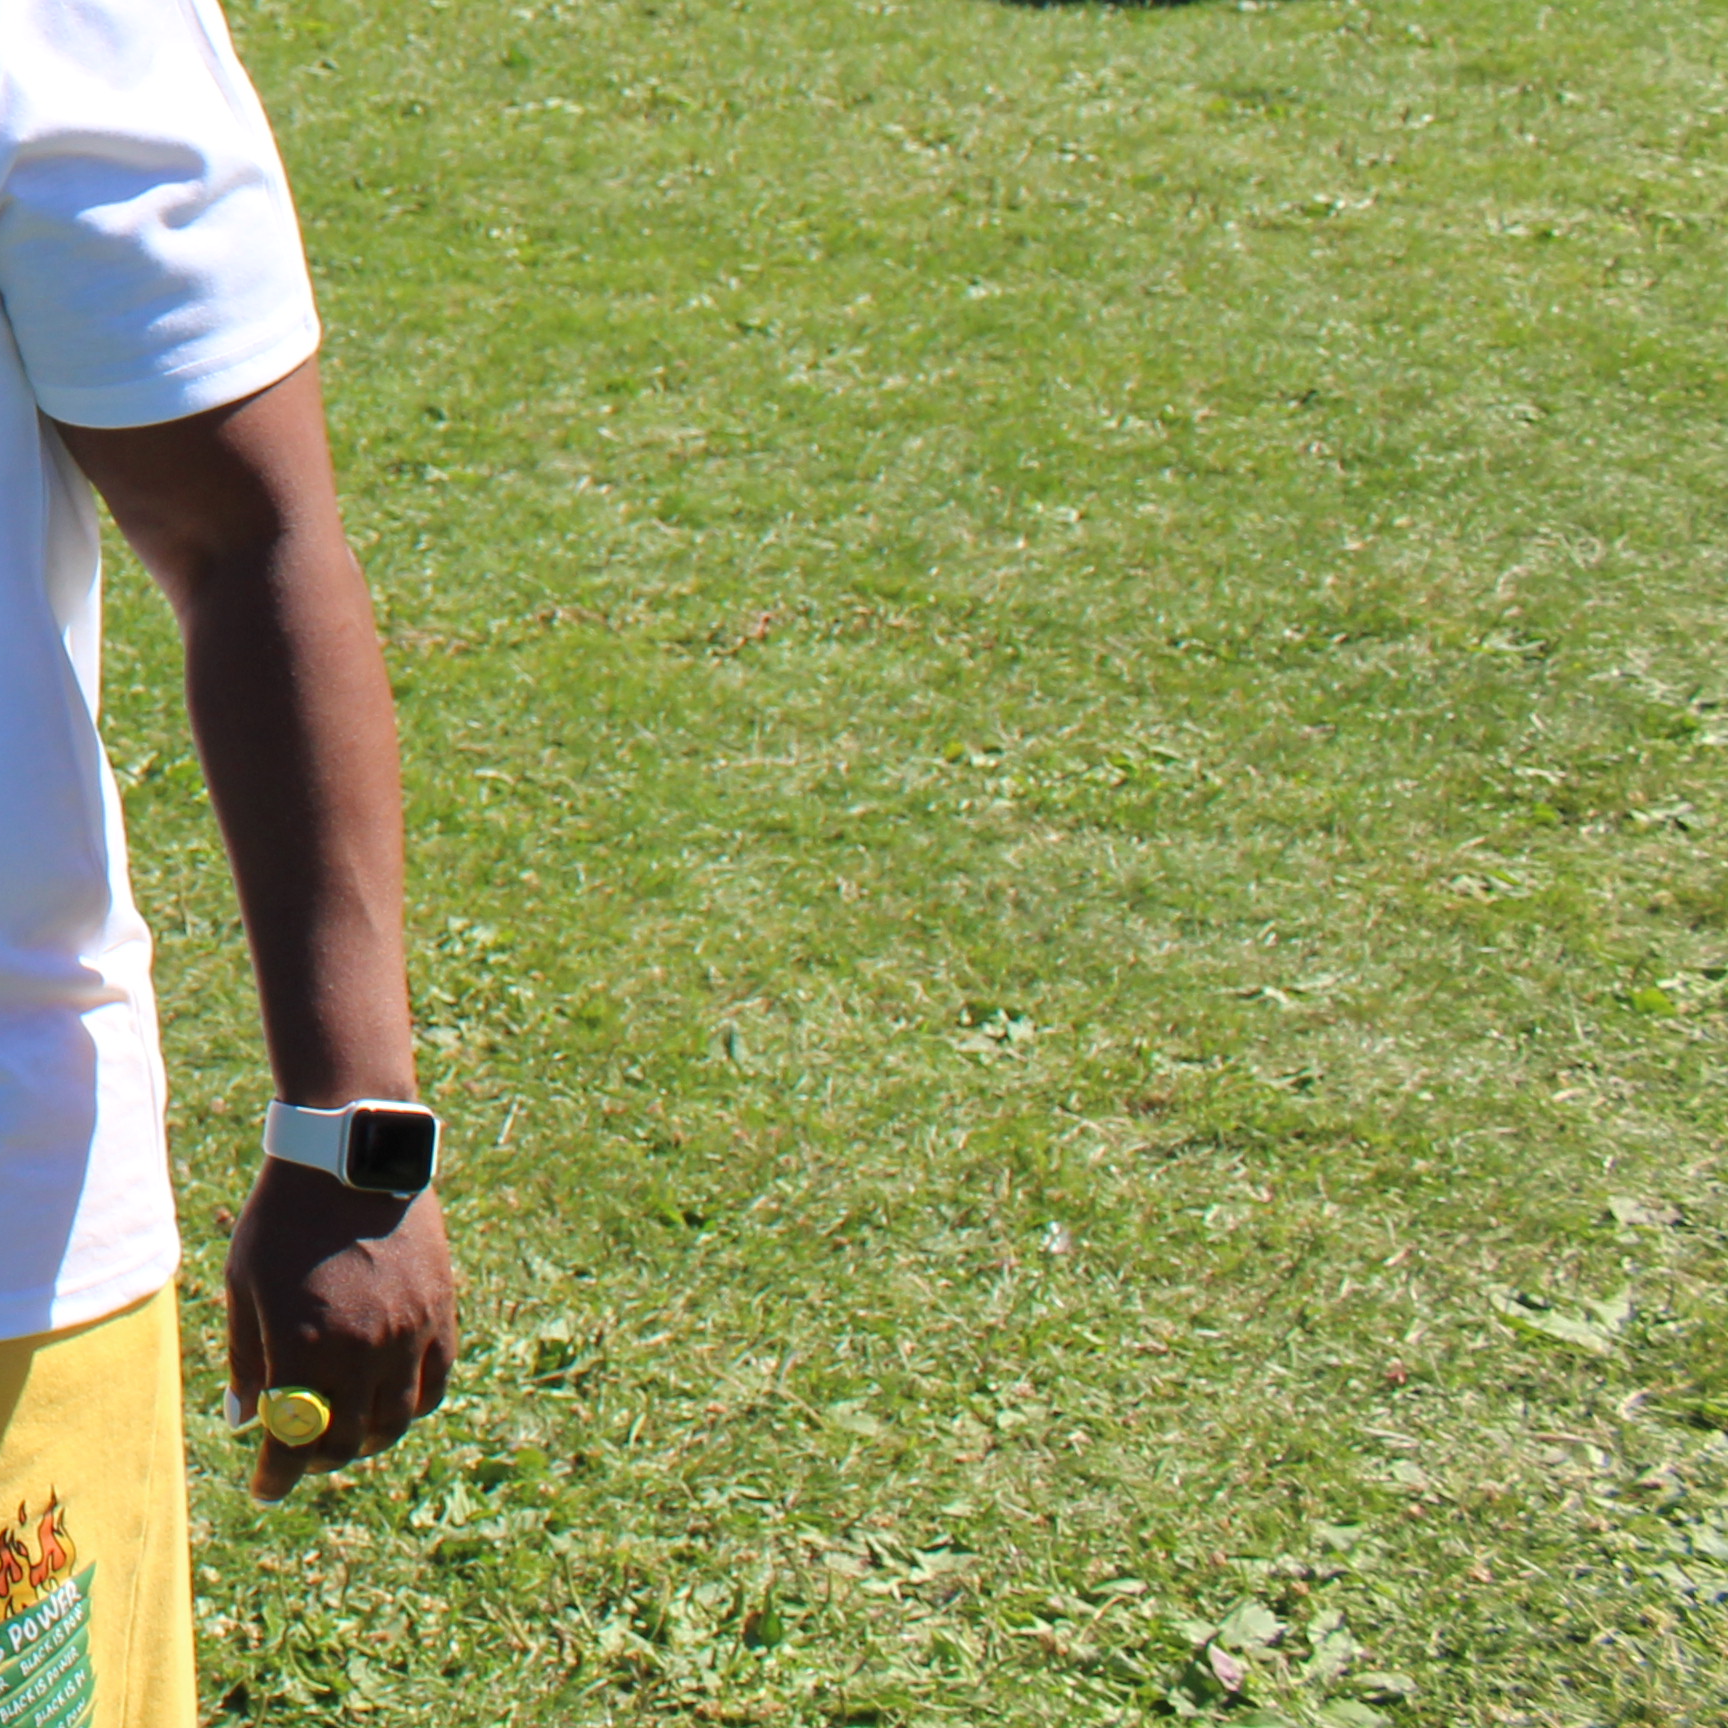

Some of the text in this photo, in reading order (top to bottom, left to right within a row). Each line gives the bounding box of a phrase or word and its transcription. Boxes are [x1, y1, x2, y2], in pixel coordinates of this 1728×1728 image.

[7, 1580, 83, 1654] POWER
[19, 1639, 54, 1677] BLACK
[52, 1627, 66, 1646] IS
[34, 1677, 48, 1698] IS
[46, 1645, 81, 1684] POWER
[33, 1691, 66, 1728] BLACK
